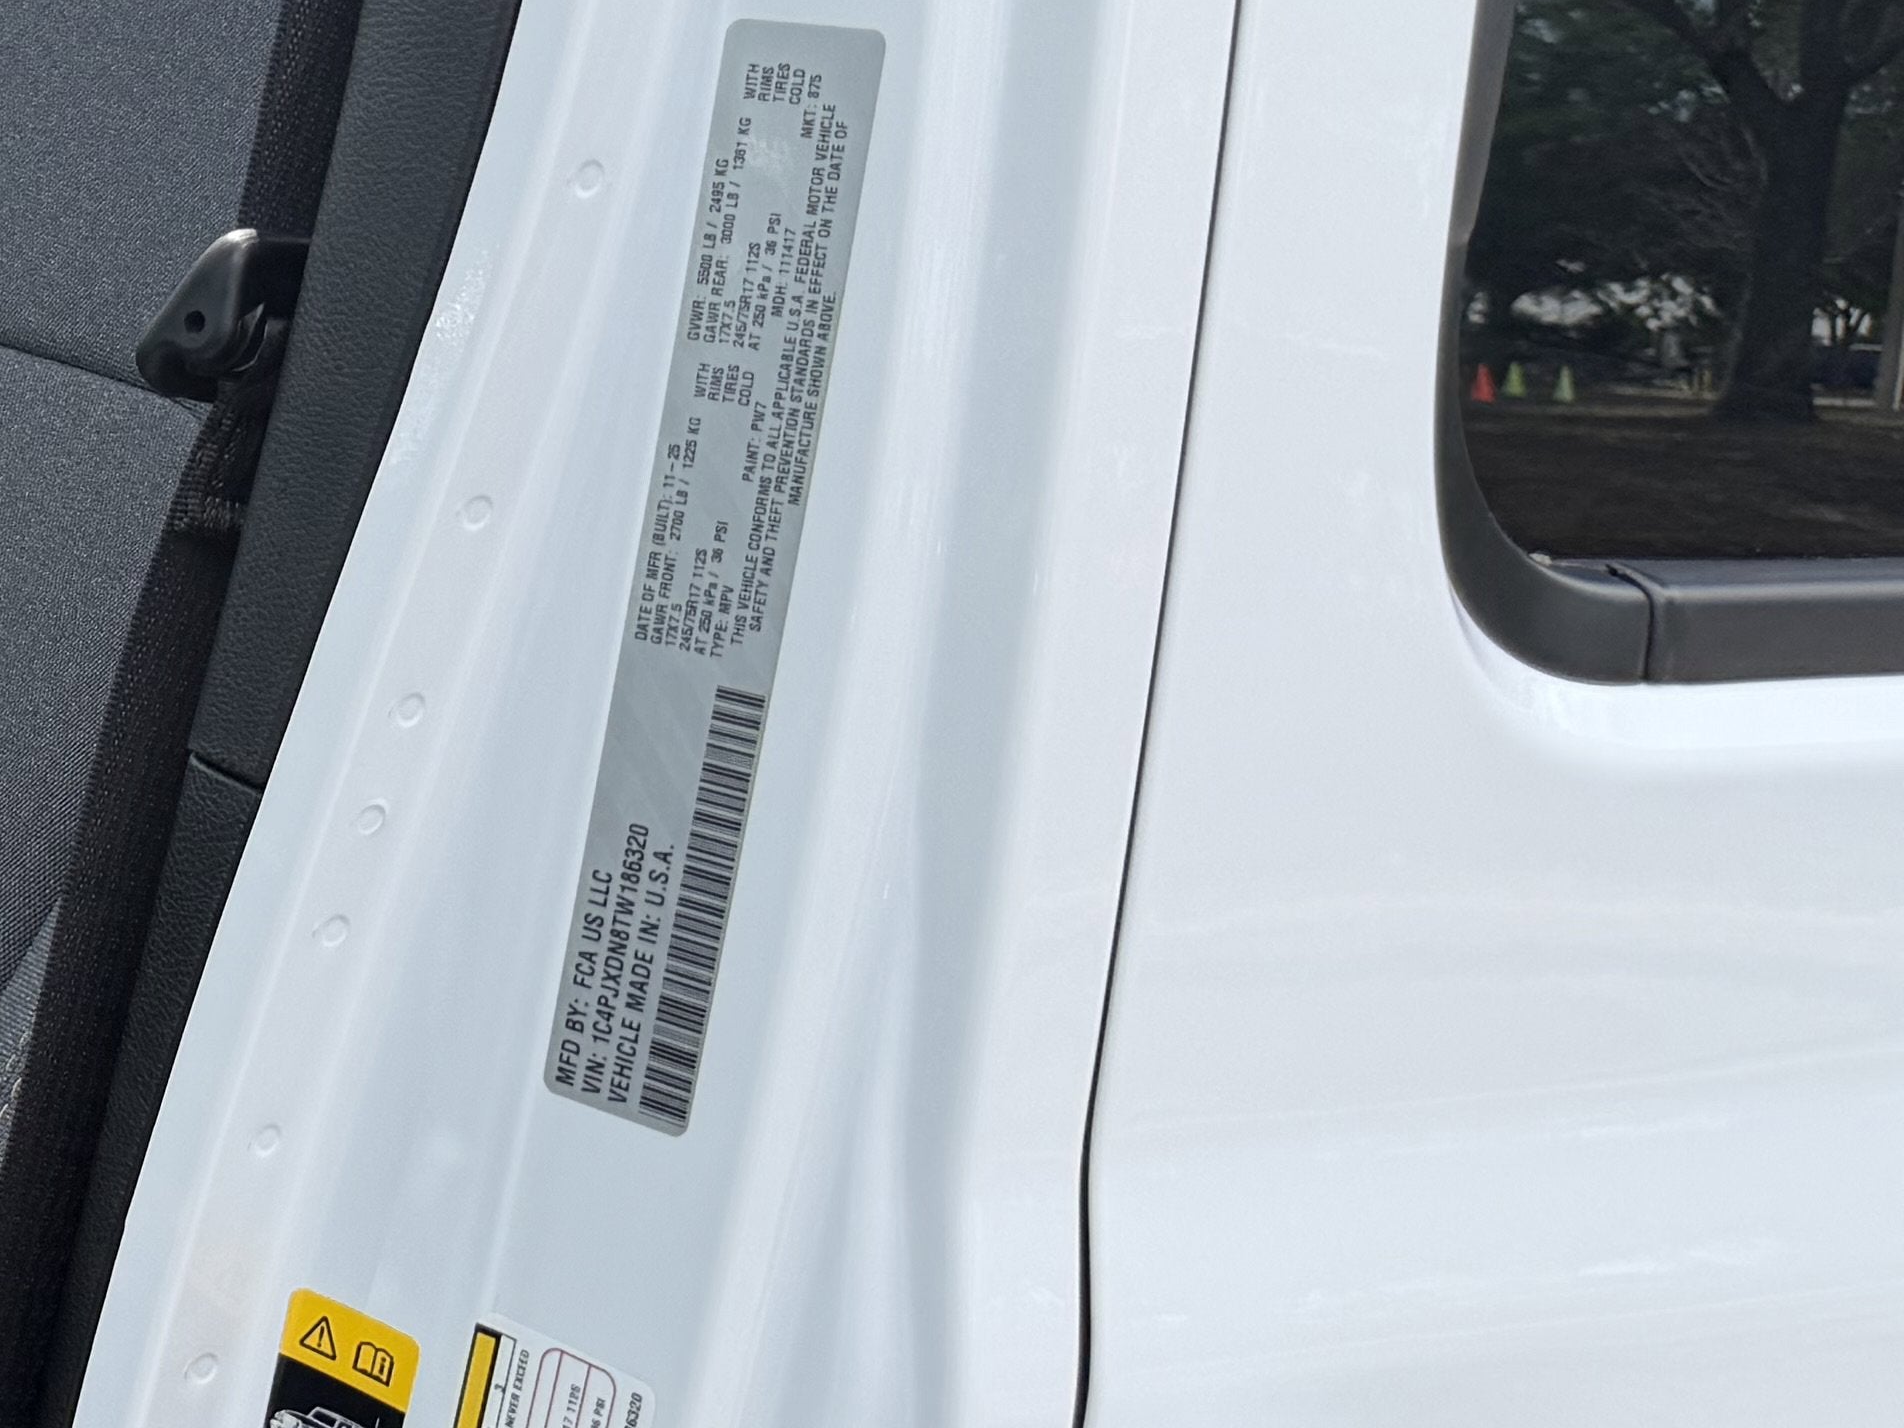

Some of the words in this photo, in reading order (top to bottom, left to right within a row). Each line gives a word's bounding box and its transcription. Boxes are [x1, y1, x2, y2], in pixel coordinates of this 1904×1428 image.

[742, 62, 761, 99] WITH
[756, 66, 776, 102] RIMS
[772, 62, 792, 103] TIRES
[787, 68, 807, 105] COLD
[806, 73, 824, 99] 875
[736, 116, 753, 136] KG
[799, 103, 819, 139] MKT:
[812, 103, 837, 161] VEHICLE
[833, 120, 850, 139] OF
[713, 157, 731, 177] KG
[730, 140, 749, 171] 1361
[825, 143, 846, 181] DATE
[707, 180, 727, 213] 2495
[724, 191, 740, 208] LB
[804, 166, 827, 215] MOTOR
[820, 185, 839, 214] THE
[701, 232, 718, 249] LB
[718, 212, 737, 245] 3000
[766, 212, 783, 234] PSI
[816, 217, 834, 238] ON
[762, 238, 779, 255] 36
[776, 227, 798, 275] 111417
[791, 219, 818, 284] FEDERAL
[695, 253, 714, 285] 5500
[709, 253, 730, 297] REAR:
[806, 242, 829, 295] EFFECT
[730, 276, 756, 348] 245/75R17
[743, 241, 762, 273] 112S
[755, 274, 772, 300] kPa
[769, 281, 789, 317] MDH:
[685, 293, 707, 341] GVWR:
[701, 300, 722, 344] GAWR
[716, 298, 737, 345] 17X7.5
[750, 302, 767, 328] 250
[803, 298, 819, 314] IN
[746, 331, 762, 351] AT
[769, 335, 798, 419] APPLICABLE
[788, 317, 817, 403] STANDARDS
[692, 362, 711, 398] WITH
[706, 365, 725, 401] RIMS
[721, 363, 741, 404] TIRES
[736, 370, 755, 407] COLD
[686, 416, 702, 435] KG
[749, 400, 768, 432] PW7
[786, 400, 819, 507] MANUFACTURE
[806, 344, 829, 397] SHOWN
[680, 437, 698, 470] 1225
[764, 421, 783, 450] ALL
[772, 406, 802, 494] PREVENTION
[740, 434, 762, 483] PAINT:
[760, 452, 777, 472] TO
[674, 488, 689, 506] LB
[746, 474, 773, 551] CONFORMS
[668, 508, 686, 541] 2700
[712, 519, 729, 543] PSI
[763, 498, 785, 542] THEFT
[644, 549, 663, 580] MFR
[709, 546, 724, 564] 36
[757, 545, 777, 577] AND
[658, 549, 679, 599] FRONT:
[735, 553, 759, 610] VEHICLE
[640, 582, 657, 603] OF
[678, 582, 702, 651] 245/75R17
[690, 547, 708, 579] 112S
[701, 580, 718, 606] kPa
[717, 584, 735, 614] MPV
[747, 578, 771, 633] SAFETY
[633, 604, 654, 641] DATE
[650, 601, 670, 645] GAWR
[664, 601, 683, 648] 17X7.5
[697, 608, 713, 634] 250
[709, 618, 729, 659] TYPE:
[729, 613, 748, 647] THIS
[693, 636, 709, 655] AT
[585, 867, 612, 908] LLC
[641, 838, 674, 908] U.S.A.
[579, 910, 605, 943] US
[589, 821, 649, 1048] 1C4PJXDN8TW186320
[635, 911, 662, 945] IN:
[571, 946, 599, 990] FCA
[623, 947, 655, 1014] MADE
[563, 995, 590, 1035] BY:
[554, 1037, 583, 1088] MFD
[580, 1049, 609, 1098] VIN:
[607, 1016, 643, 1107] VEHICLE
[512, 1348, 530, 1391] EXCEED
[504, 1391, 521, 1428] NEVER
[592, 1395, 606, 1417] PSI
